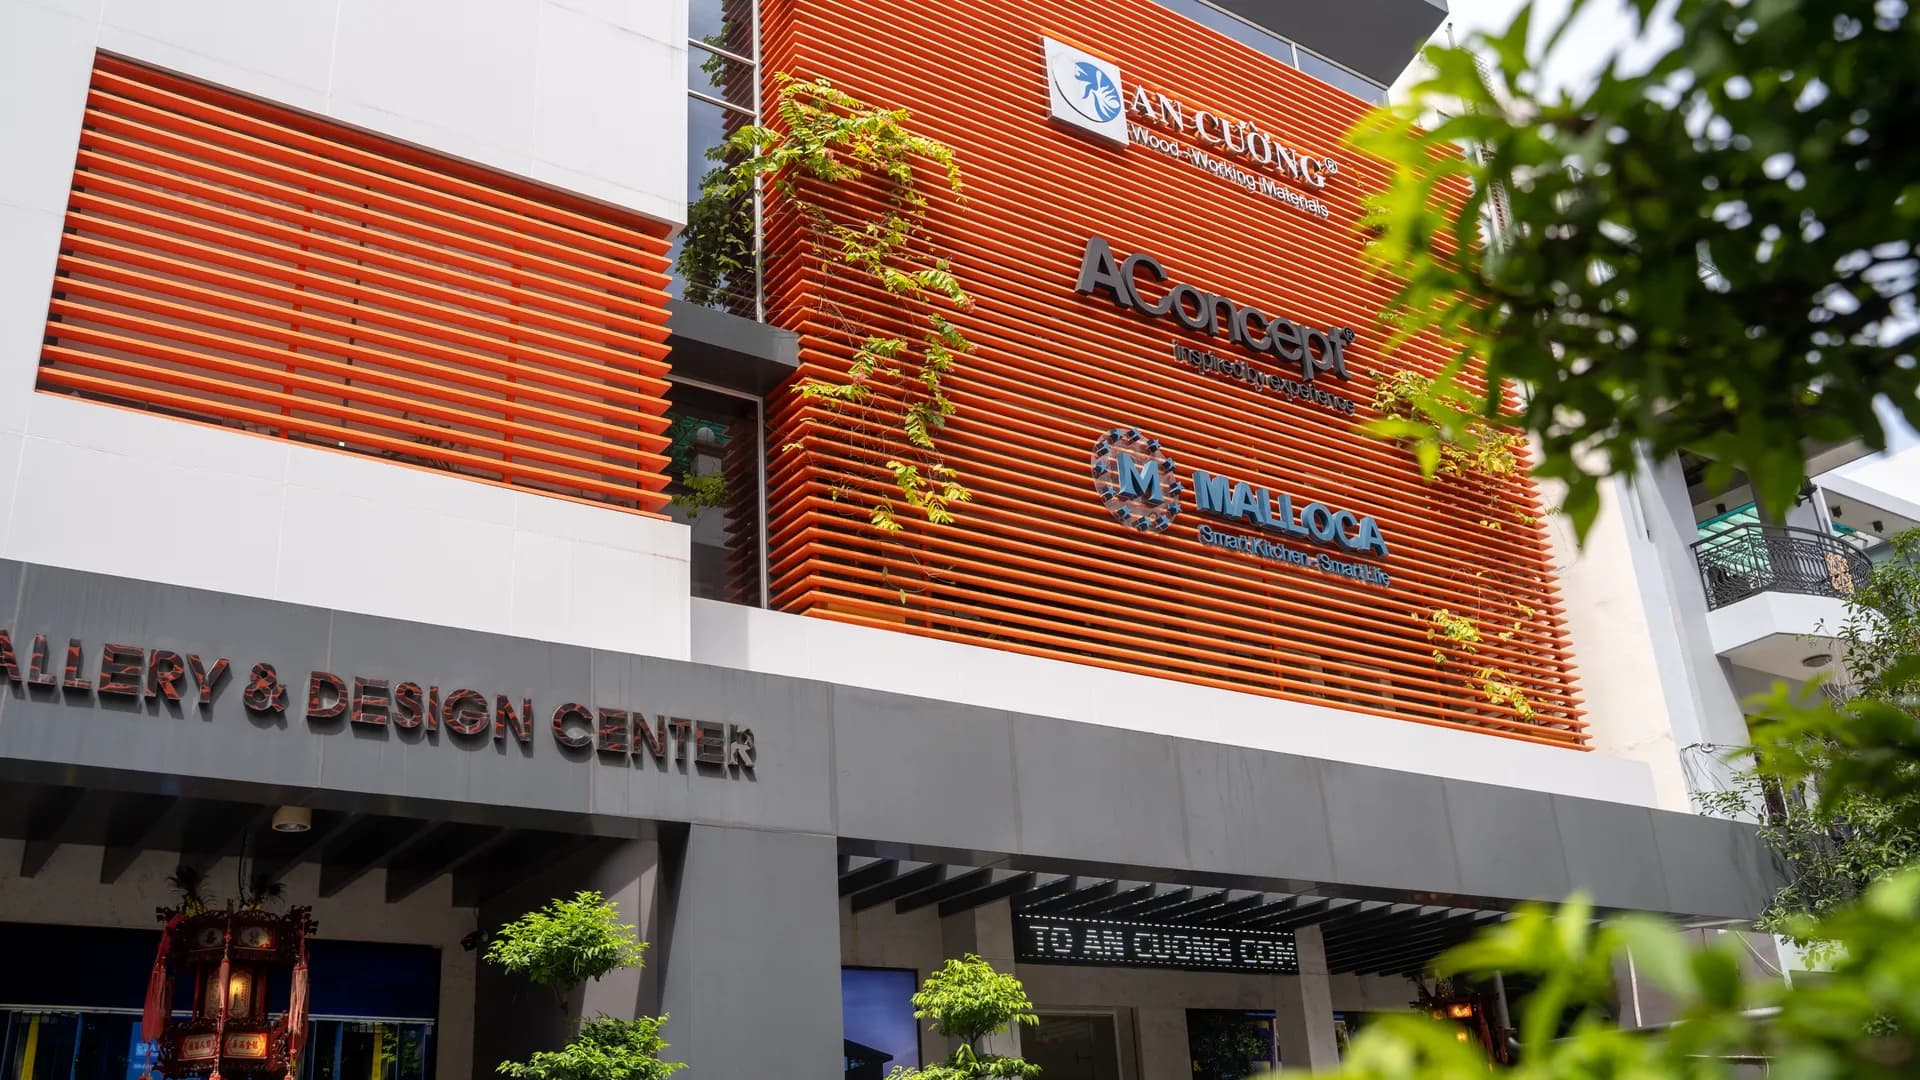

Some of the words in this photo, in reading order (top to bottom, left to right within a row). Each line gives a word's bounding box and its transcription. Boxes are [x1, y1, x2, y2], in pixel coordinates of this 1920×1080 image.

[1131, 84, 1184, 133] AN
[1130, 122, 1181, 160] Wood
[1190, 147, 1257, 193] Working
[1260, 175, 1330, 219] Materials
[1171, 338, 1246, 381] inspired
[1246, 361, 1267, 393] by
[1267, 373, 1357, 416] experience
[1192, 470, 1390, 557] MALLOCA
[1198, 523, 1251, 553] Smart
[1250, 537, 1311, 567] Kitchen
[1317, 553, 1366, 582] Smart
[1365, 564, 1392, 588] Life
[243, 662, 289, 713] &
[306, 671, 534, 743] DESIGN
[551, 702, 756, 769] CENTER
[1029, 926, 1073, 953] TO
[1083, 929, 1125, 957] AN
[1133, 932, 1233, 962] CUONG
